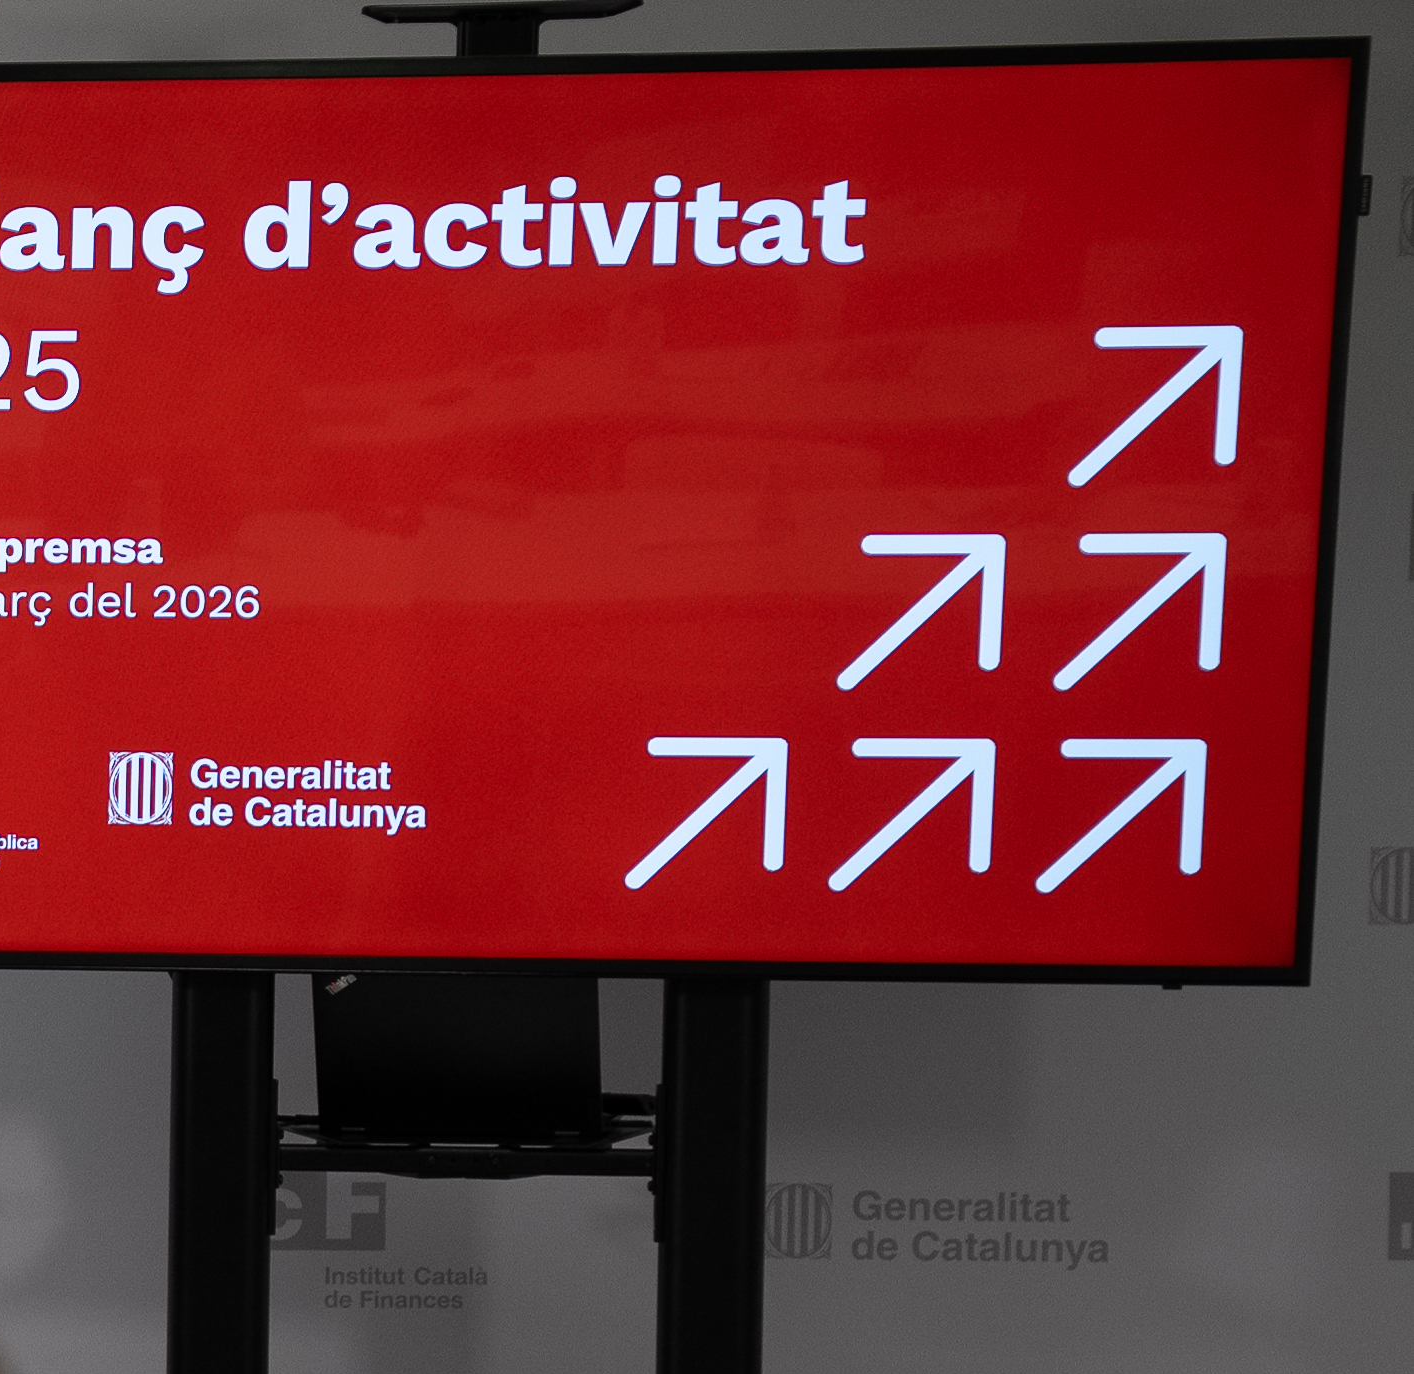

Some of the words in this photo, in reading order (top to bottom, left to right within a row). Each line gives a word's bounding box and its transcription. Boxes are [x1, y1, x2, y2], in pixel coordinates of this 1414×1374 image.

[69, 582, 137, 618] del
[153, 585, 260, 619] 2026
[190, 758, 392, 791] Generalitat
[188, 796, 234, 827] de
[244, 796, 426, 836] Catalunya
[851, 1189, 1070, 1223] Generalitat
[851, 1230, 899, 1261] de
[911, 1230, 1109, 1271] Catalunya
[324, 1266, 406, 1286] Institut
[413, 1266, 487, 1287] Català
[323, 1289, 353, 1309] de
[360, 1290, 465, 1310] Finances
